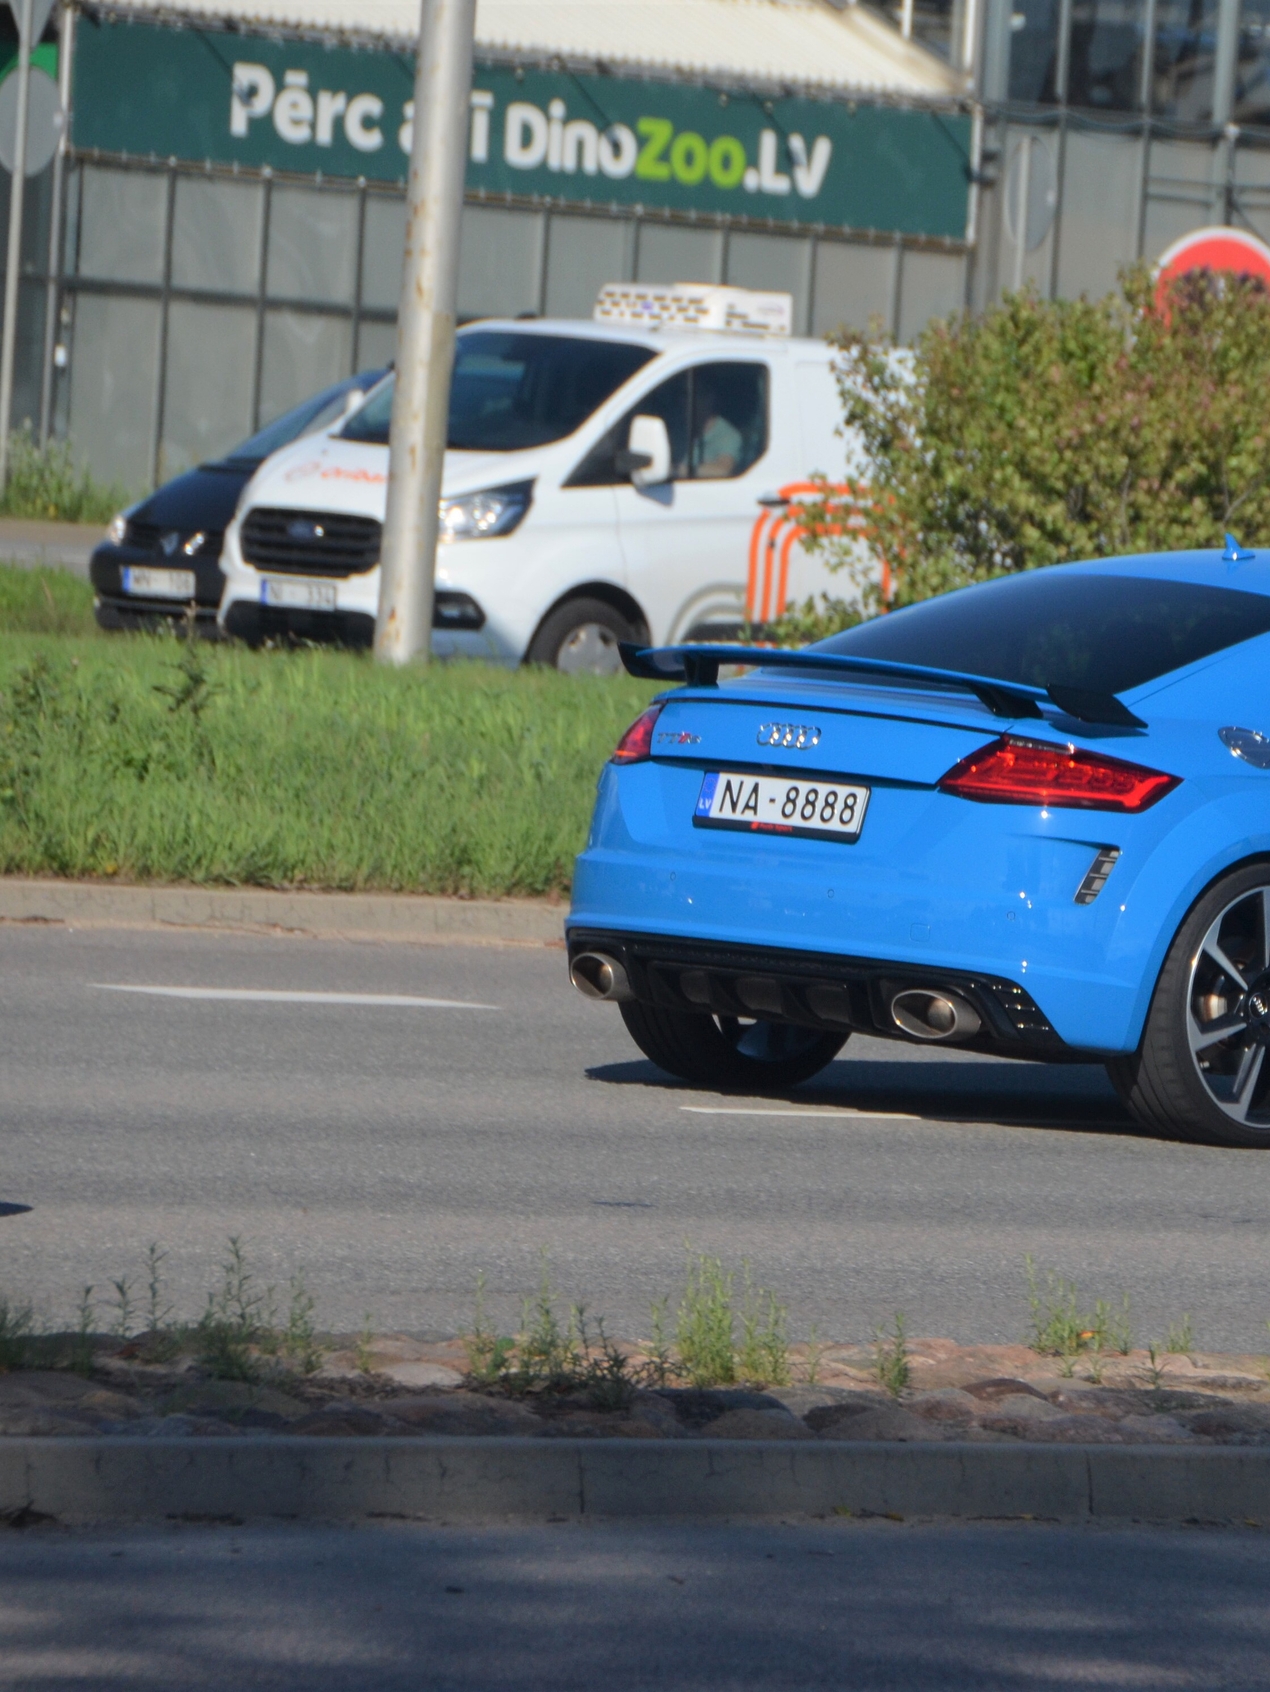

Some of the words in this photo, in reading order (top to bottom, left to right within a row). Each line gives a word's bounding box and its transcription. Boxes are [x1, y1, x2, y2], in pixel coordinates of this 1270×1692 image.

[230, 61, 384, 152] Pērc
[504, 97, 832, 199] DinoZoo.LV
[698, 797, 712, 809] LV
